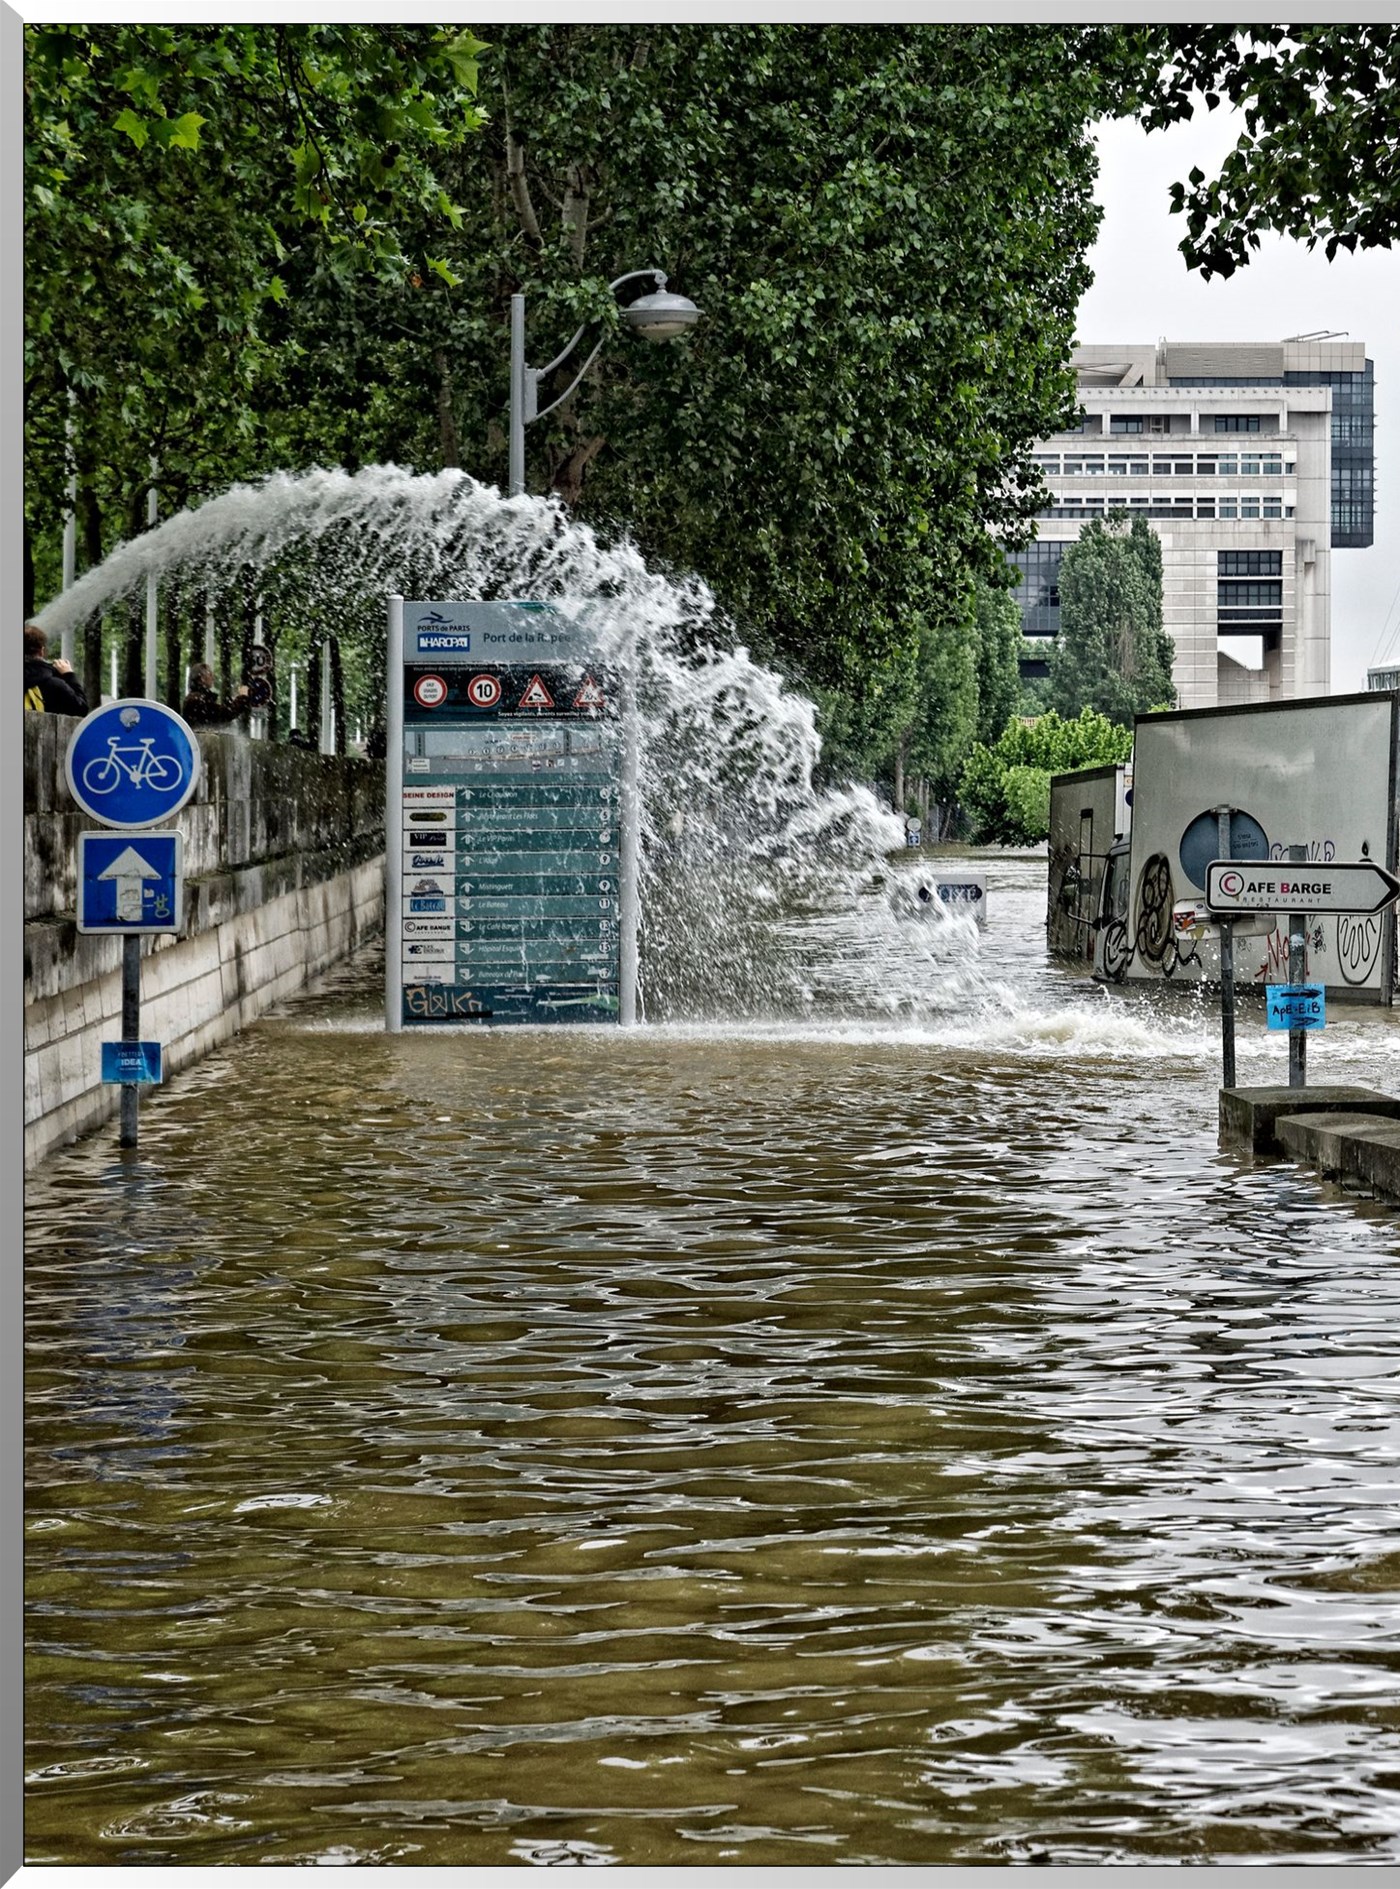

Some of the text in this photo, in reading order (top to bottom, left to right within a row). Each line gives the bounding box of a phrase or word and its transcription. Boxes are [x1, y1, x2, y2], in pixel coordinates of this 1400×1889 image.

[483, 633, 506, 643] Port
[509, 633, 522, 643] de
[525, 633, 534, 643] la
[477, 684, 493, 698] 10
[1281, 882, 1332, 895] BARGE
[121, 1058, 142, 1066] IDEA
